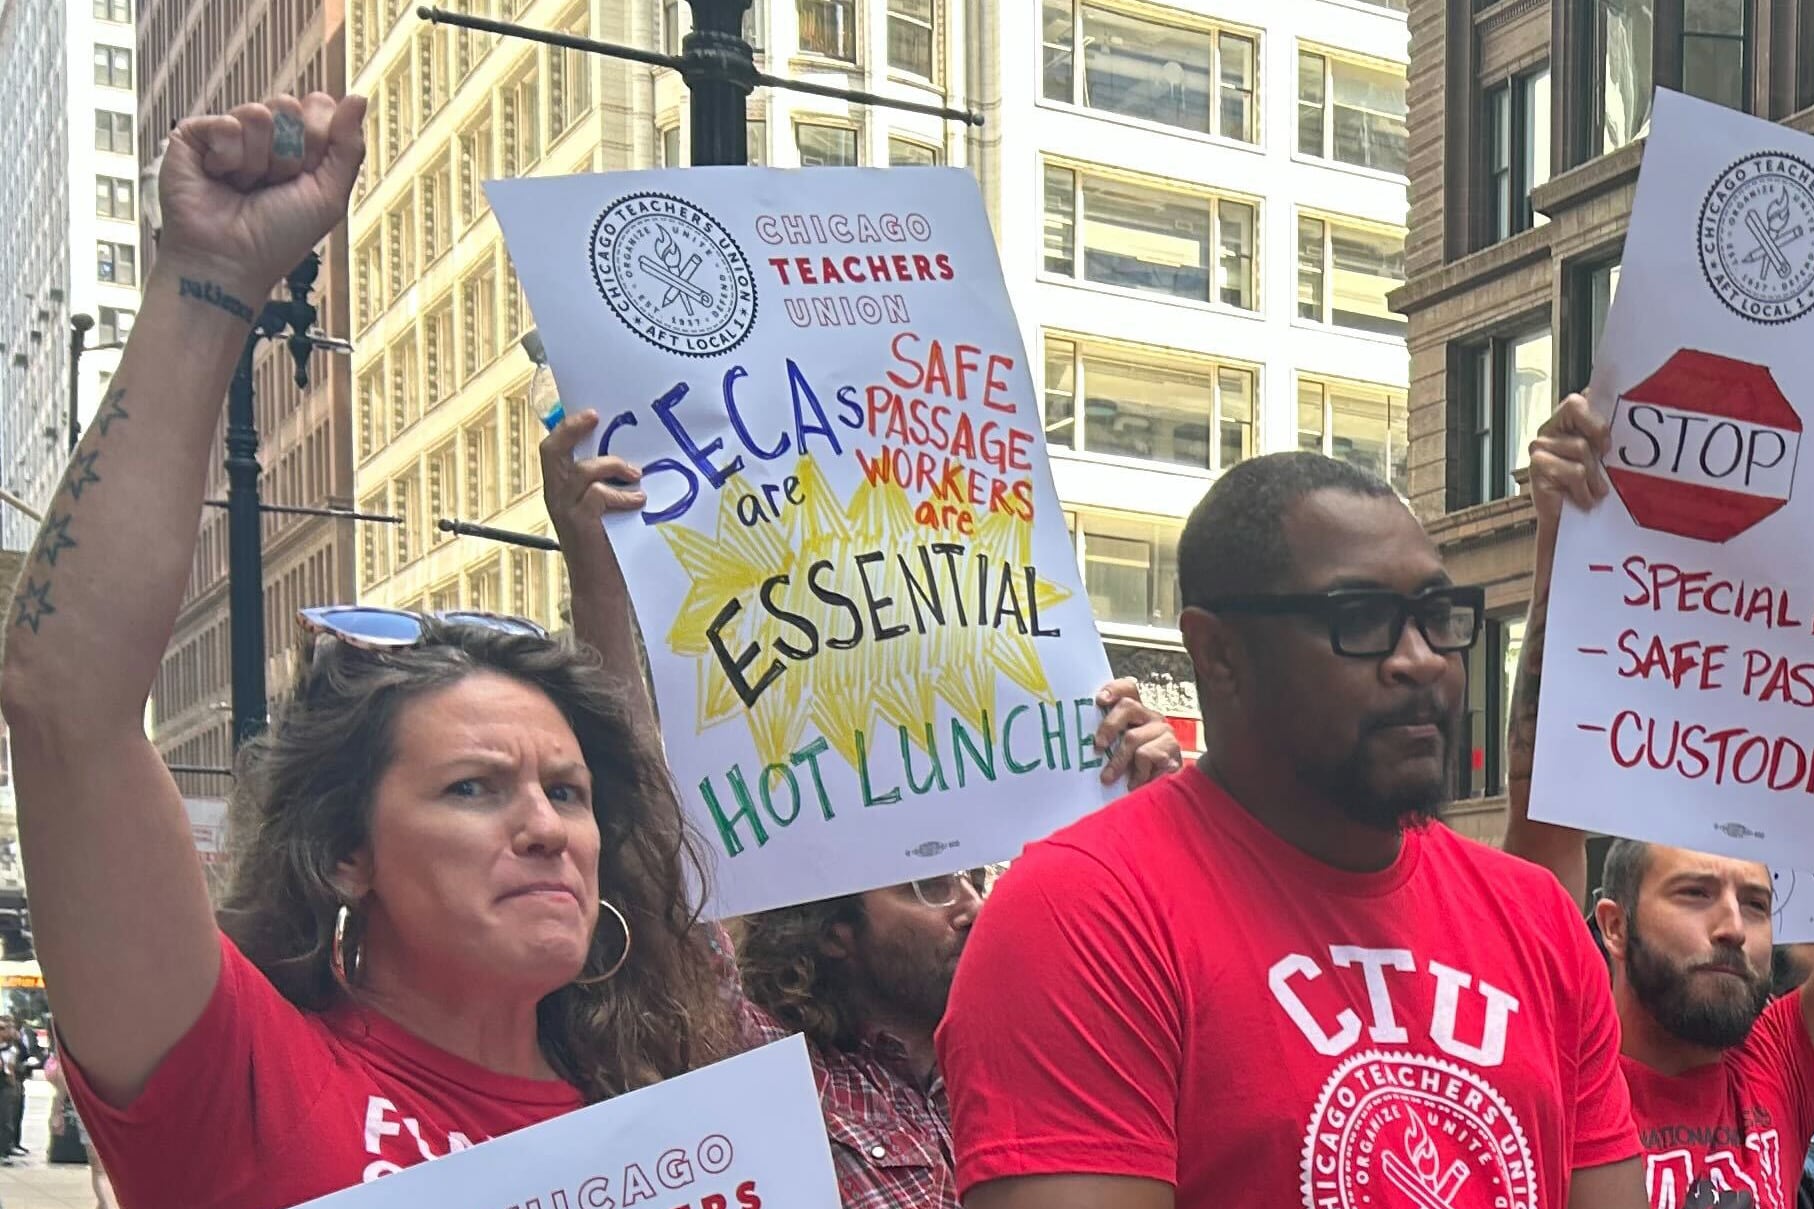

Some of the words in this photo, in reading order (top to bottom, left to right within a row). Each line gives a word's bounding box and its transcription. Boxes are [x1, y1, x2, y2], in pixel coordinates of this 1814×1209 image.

[755, 212, 932, 245] CHICAGO
[1704, 168, 1747, 254] CHICAGO
[597, 223, 630, 312] CHICAGO
[614, 199, 714, 234] TEACHERS
[718, 237, 752, 302] UNION
[768, 254, 955, 286] TEACHERS
[783, 294, 911, 328] UNION
[1713, 273, 1740, 302] AFT
[1740, 299, 1793, 318] LOCAL
[645, 325, 680, 347] AFT
[686, 328, 737, 351] LOCAL
[886, 332, 1017, 415] SAFE
[865, 385, 1036, 471] PASSAGE
[1618, 403, 1787, 487] STOP
[737, 475, 806, 527] are
[856, 448, 1036, 523] WORKERS
[914, 500, 976, 536] are
[705, 542, 1061, 710] ESSENTIAL
[698, 736, 837, 859] HOT
[854, 698, 1108, 810] LUNCHE
[1267, 944, 1520, 1068] CTU
[1354, 1063, 1500, 1125] TEACHERS
[1356, 1104, 1402, 1185] ORGANIZE
[1427, 1112, 1493, 1166] UNITE
